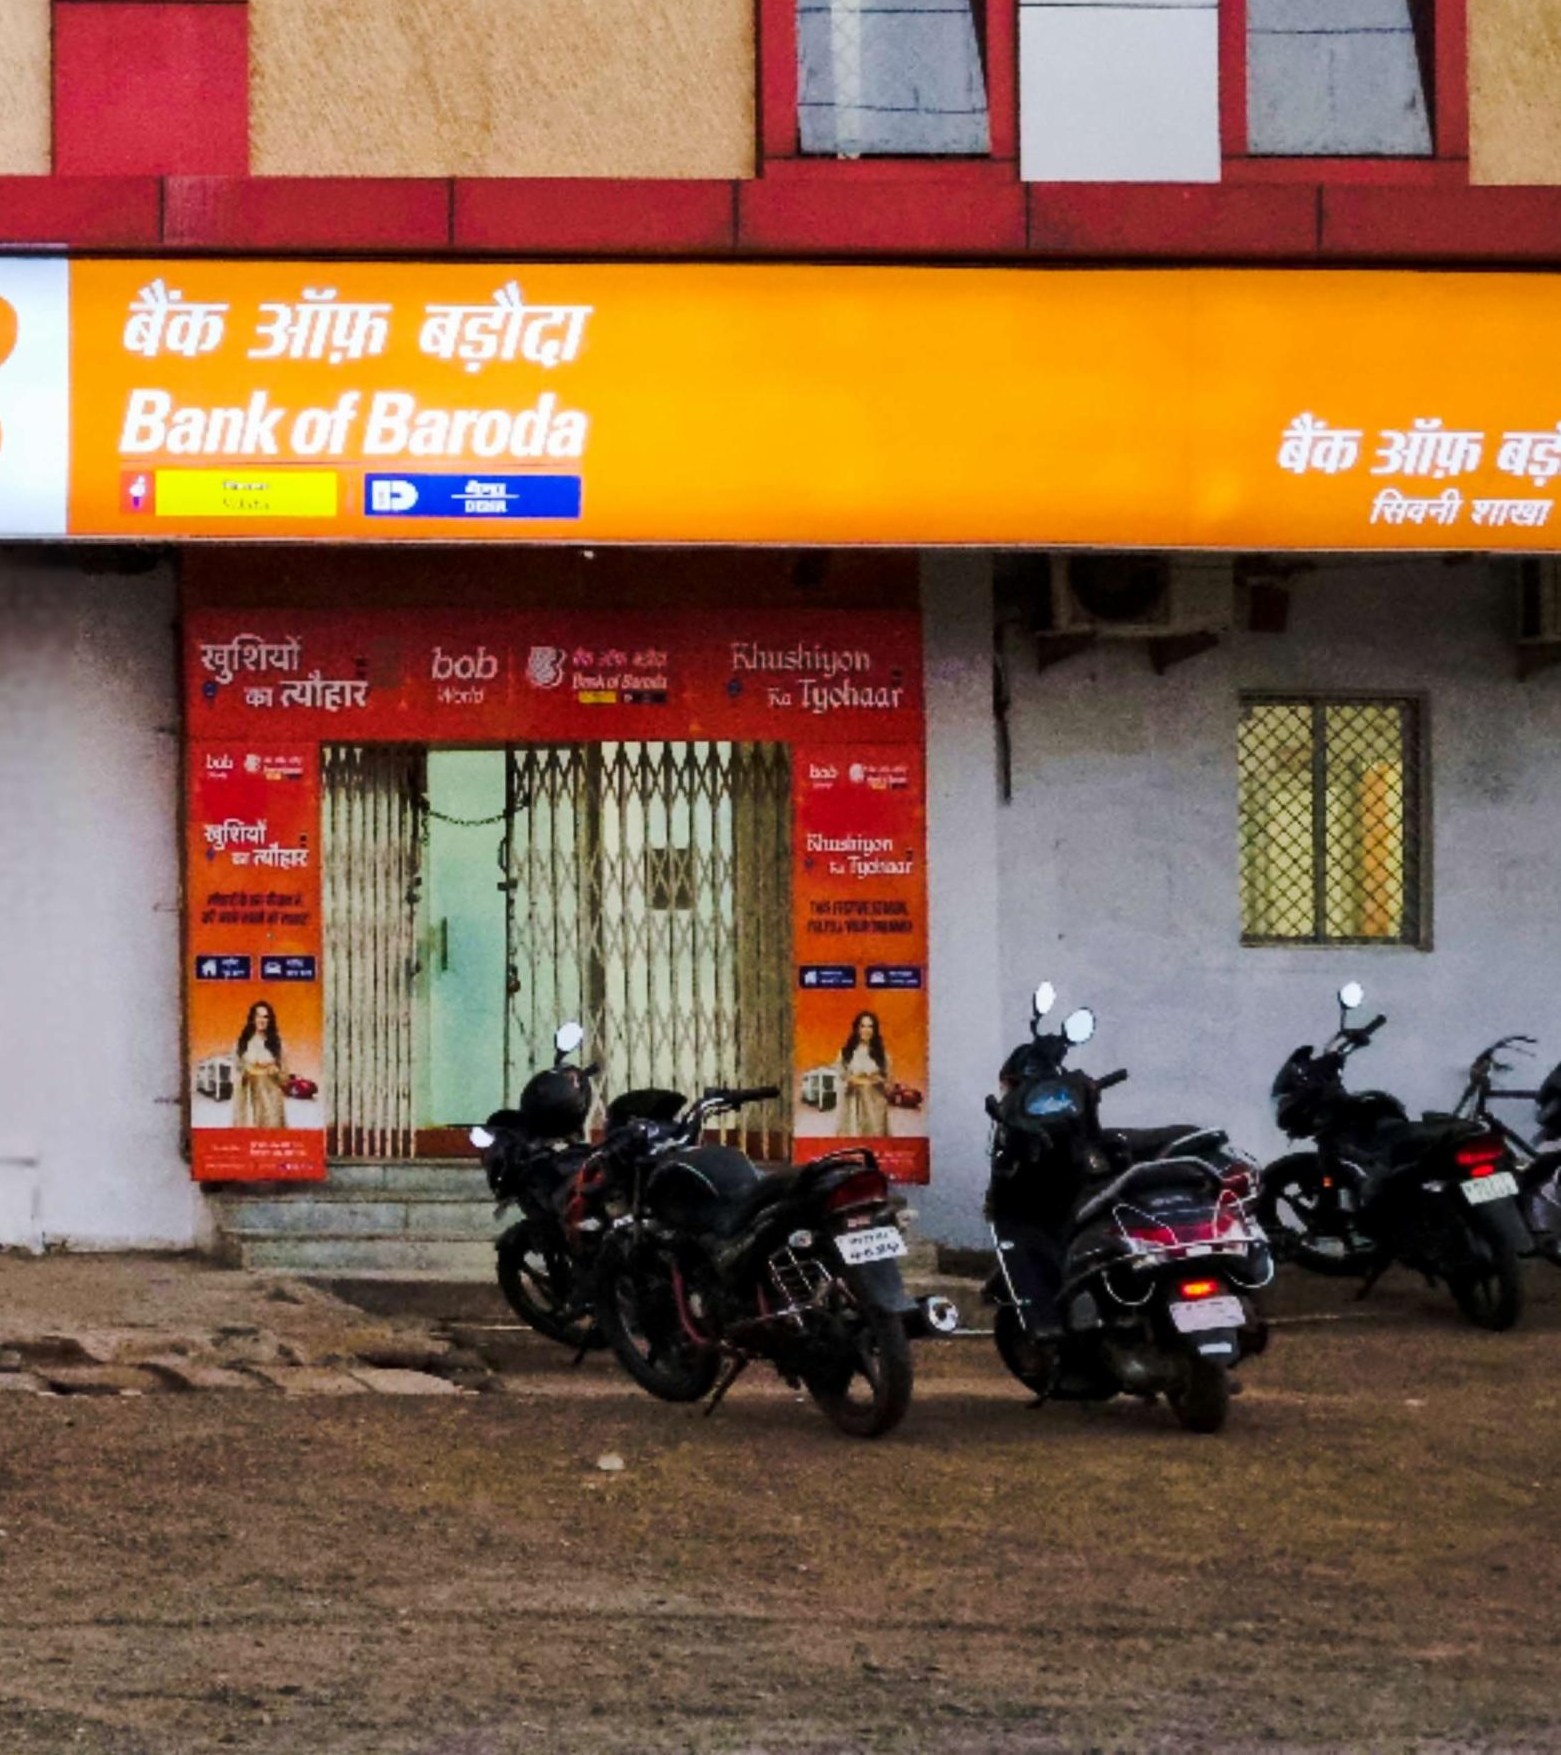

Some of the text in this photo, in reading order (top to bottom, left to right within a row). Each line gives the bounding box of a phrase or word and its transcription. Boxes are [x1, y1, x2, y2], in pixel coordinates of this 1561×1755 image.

[123, 278, 230, 358] बैंक
[419, 280, 595, 374] बड़ौदा
[119, 388, 587, 457] Bank of Baroda
[1278, 412, 1364, 474] बैंक
[1470, 498, 1555, 527] शाखा
[200, 633, 302, 684] खुशियों
[431, 646, 499, 679] bob
[731, 642, 871, 678] Khushiyon
